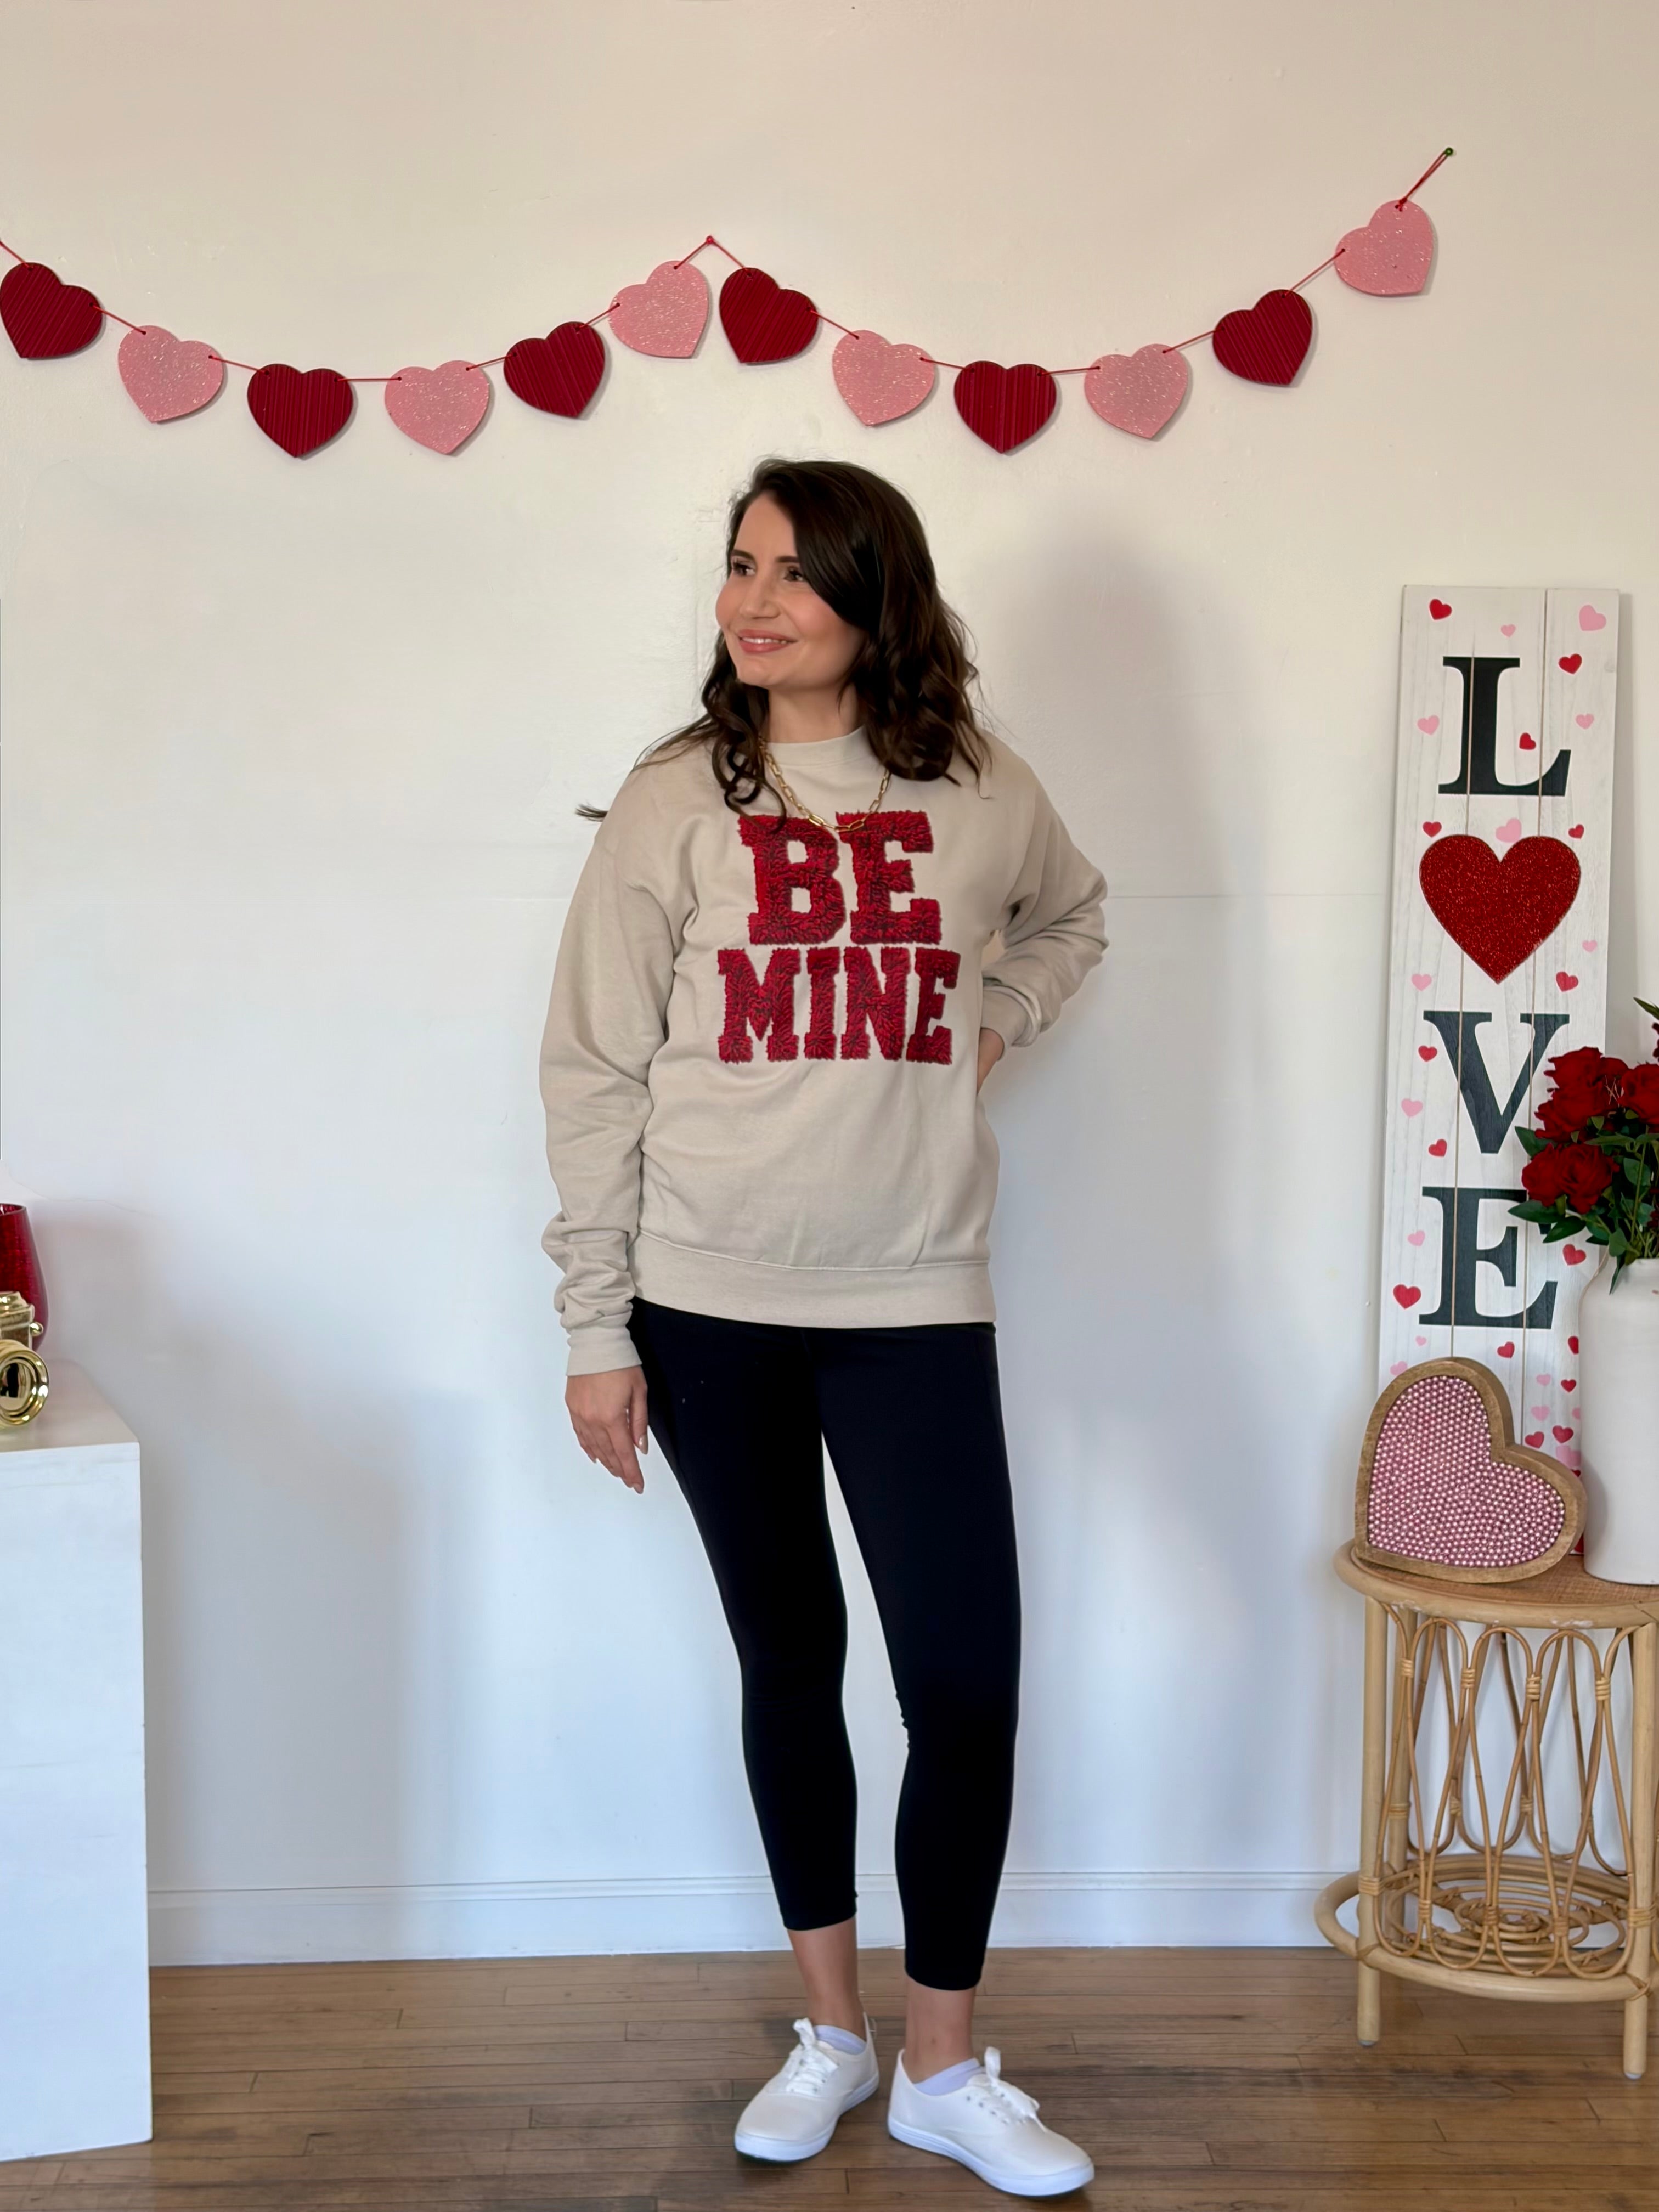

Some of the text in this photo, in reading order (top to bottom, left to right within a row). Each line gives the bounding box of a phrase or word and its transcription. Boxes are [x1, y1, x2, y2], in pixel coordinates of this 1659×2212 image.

[738, 810, 941, 945] BE
[718, 946, 961, 1064] MINE
[1419, 656, 1581, 1329] LVE
